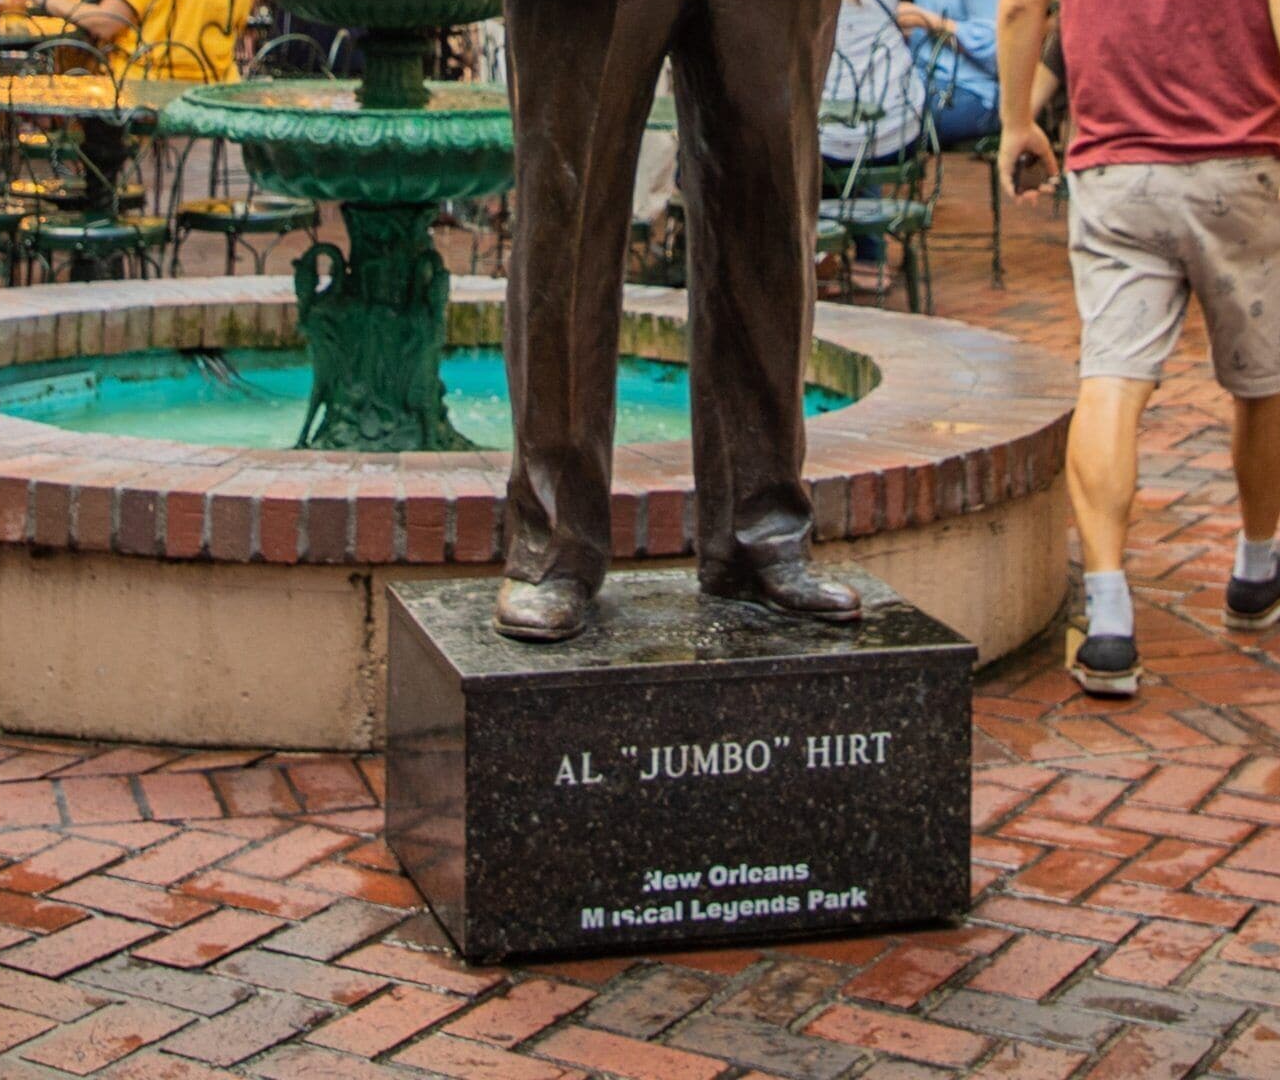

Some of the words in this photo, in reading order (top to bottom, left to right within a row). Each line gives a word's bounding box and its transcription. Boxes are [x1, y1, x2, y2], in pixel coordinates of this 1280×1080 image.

[554, 751, 603, 785] AL
[621, 736, 790, 781] "JUMBO"
[806, 731, 892, 769] HIRT
[708, 863, 810, 887] Orleans
[807, 885, 868, 911] Park
